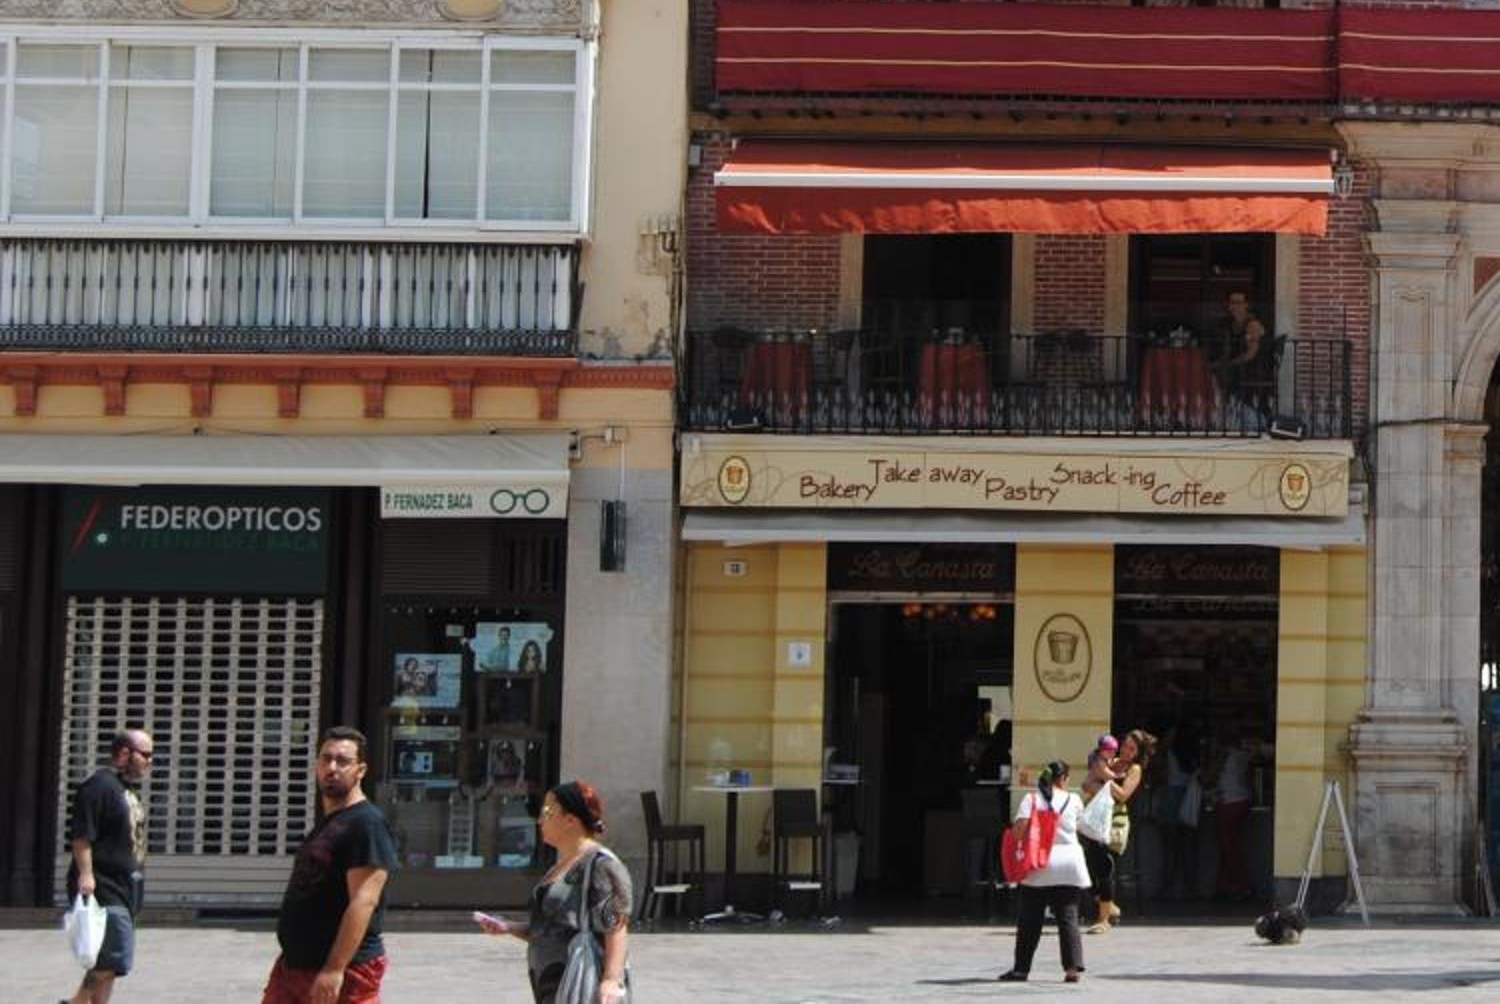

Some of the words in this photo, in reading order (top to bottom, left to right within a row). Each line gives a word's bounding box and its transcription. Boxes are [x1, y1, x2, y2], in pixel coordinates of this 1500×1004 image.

[868, 459, 921, 484] Take
[929, 465, 987, 486] away
[1050, 463, 1118, 486] Snack
[447, 493, 473, 509] BACA
[800, 475, 878, 501] Bakery
[985, 478, 1060, 505] Pastry
[1151, 483, 1227, 507] Coffee
[120, 504, 322, 532] FEDEROPTICOS
